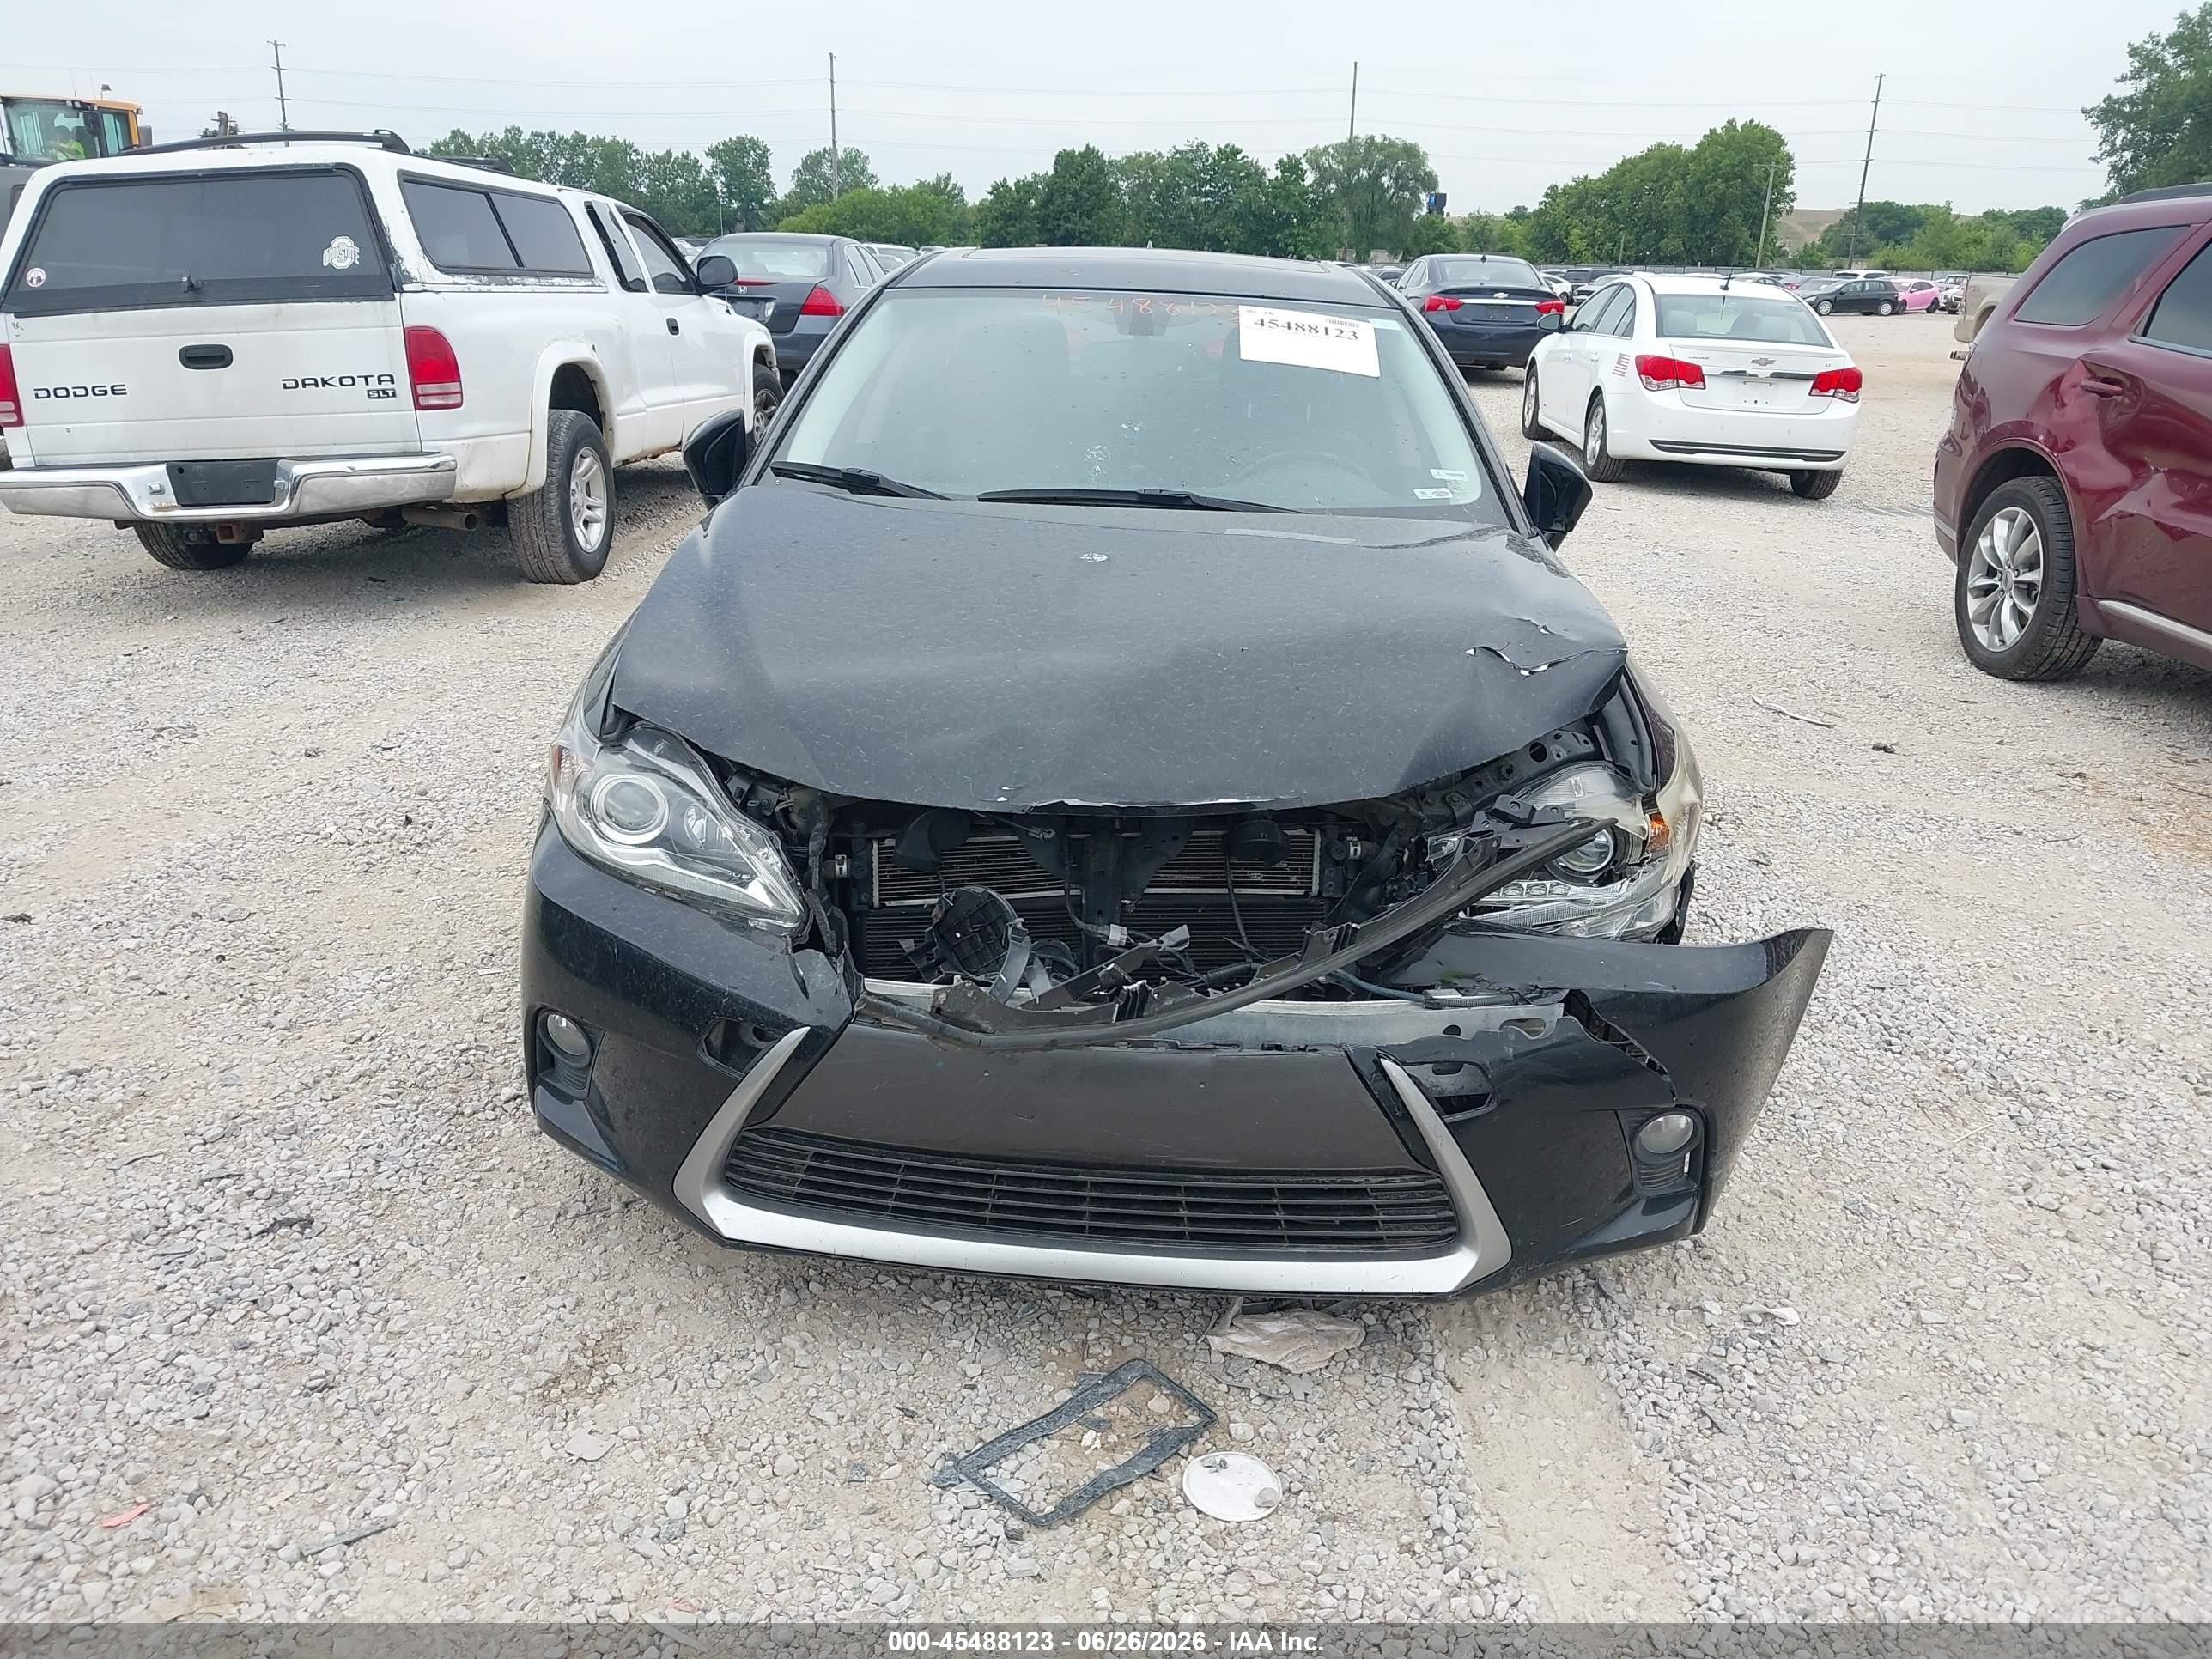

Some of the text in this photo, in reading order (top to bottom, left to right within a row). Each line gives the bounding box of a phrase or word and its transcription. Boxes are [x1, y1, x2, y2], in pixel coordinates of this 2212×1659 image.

[1254, 317, 1359, 341] 45488123
[281, 374, 395, 390] DAKOTA
[33, 384, 128, 399] DODGE
[368, 390, 396, 398] SLT
